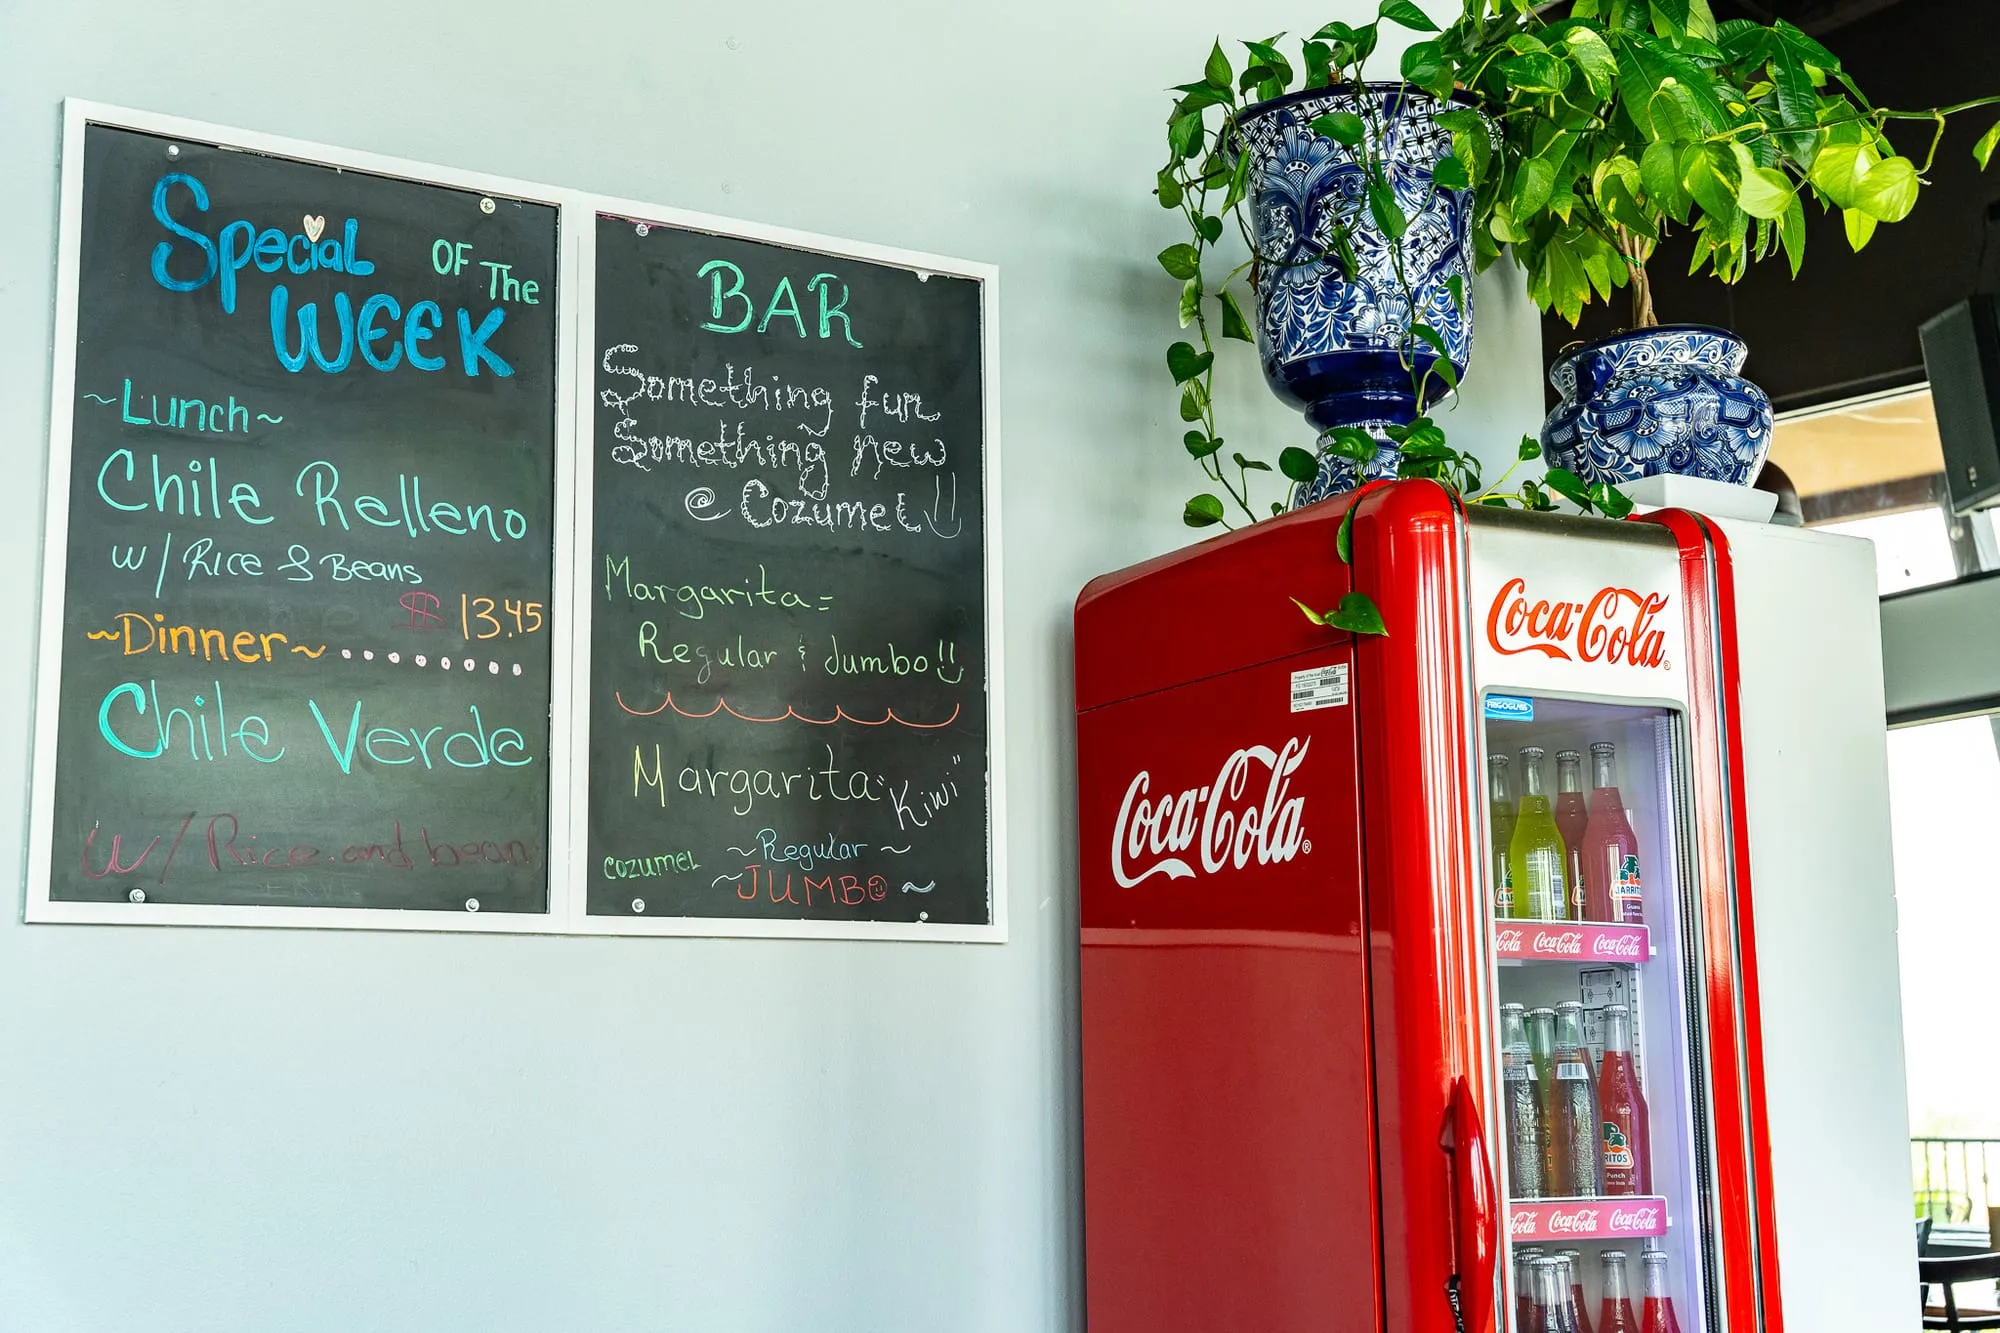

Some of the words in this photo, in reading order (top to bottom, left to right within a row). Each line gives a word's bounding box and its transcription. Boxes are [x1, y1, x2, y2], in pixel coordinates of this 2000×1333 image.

[432, 238, 473, 276] OF
[479, 260, 541, 304] The
[696, 259, 863, 348] BAR
[269, 285, 515, 377] WEEK
[600, 343, 834, 437] Something
[856, 374, 941, 429] fun
[97, 448, 275, 525] Chile
[295, 460, 528, 542] Relleno
[611, 417, 829, 500] Something
[850, 434, 947, 480] new
[277, 544, 314, 582] &
[318, 552, 423, 584] Beans
[638, 620, 778, 684] Regular
[1487, 576, 1670, 669] Coca-Cola
[99, 678, 286, 763] Chile
[307, 699, 533, 775] Verde
[634, 743, 882, 817] Margarita
[1111, 734, 1312, 889] Coca-Cola
[205, 812, 320, 872] Rice
[755, 828, 869, 871] Regular
[1533, 930, 1584, 955] Coca-Cola
[1593, 933, 1642, 956] Coca-Cola
[1548, 1210, 1600, 1234] Coca-Cola
[1609, 1207, 1660, 1232] Coca-Cola
